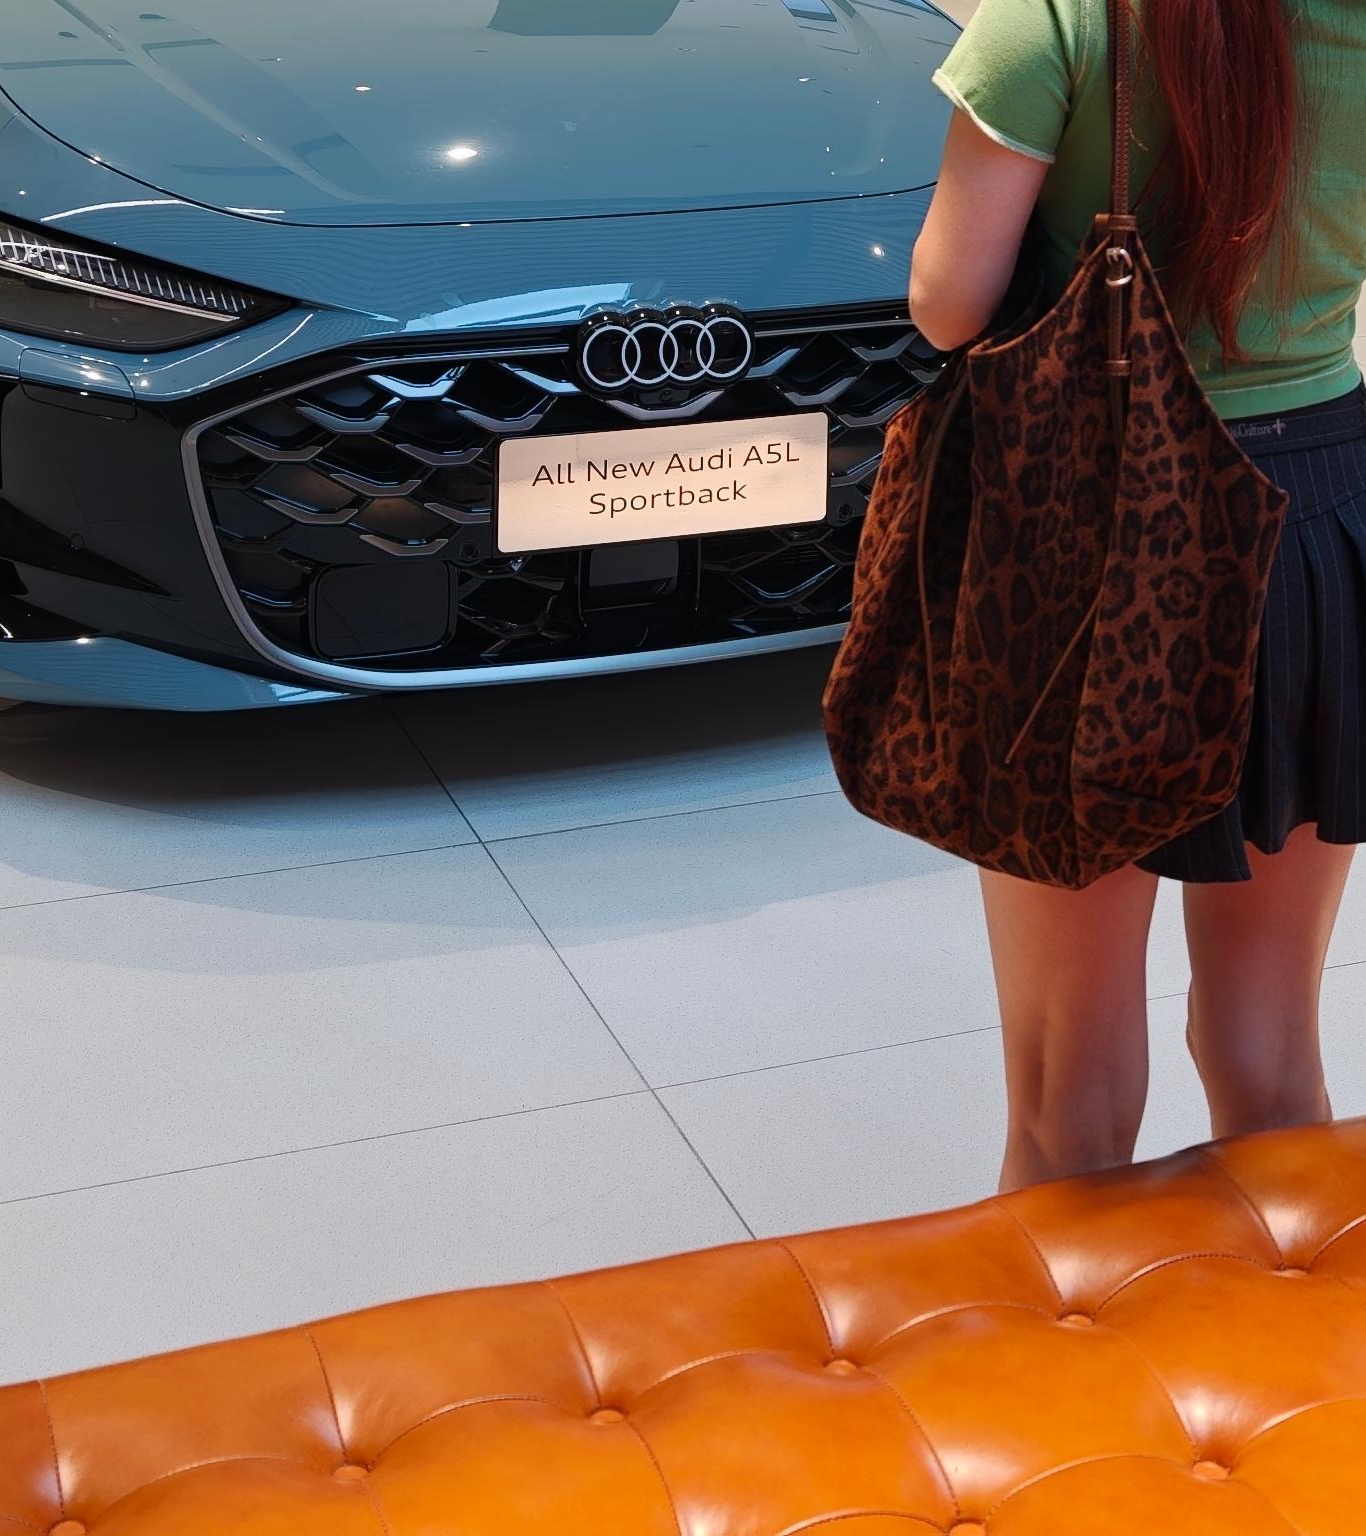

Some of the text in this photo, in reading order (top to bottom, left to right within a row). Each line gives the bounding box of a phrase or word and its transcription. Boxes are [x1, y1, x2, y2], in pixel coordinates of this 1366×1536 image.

[532, 441, 800, 487] All New Audi A5L
[589, 480, 747, 519] Sportback
